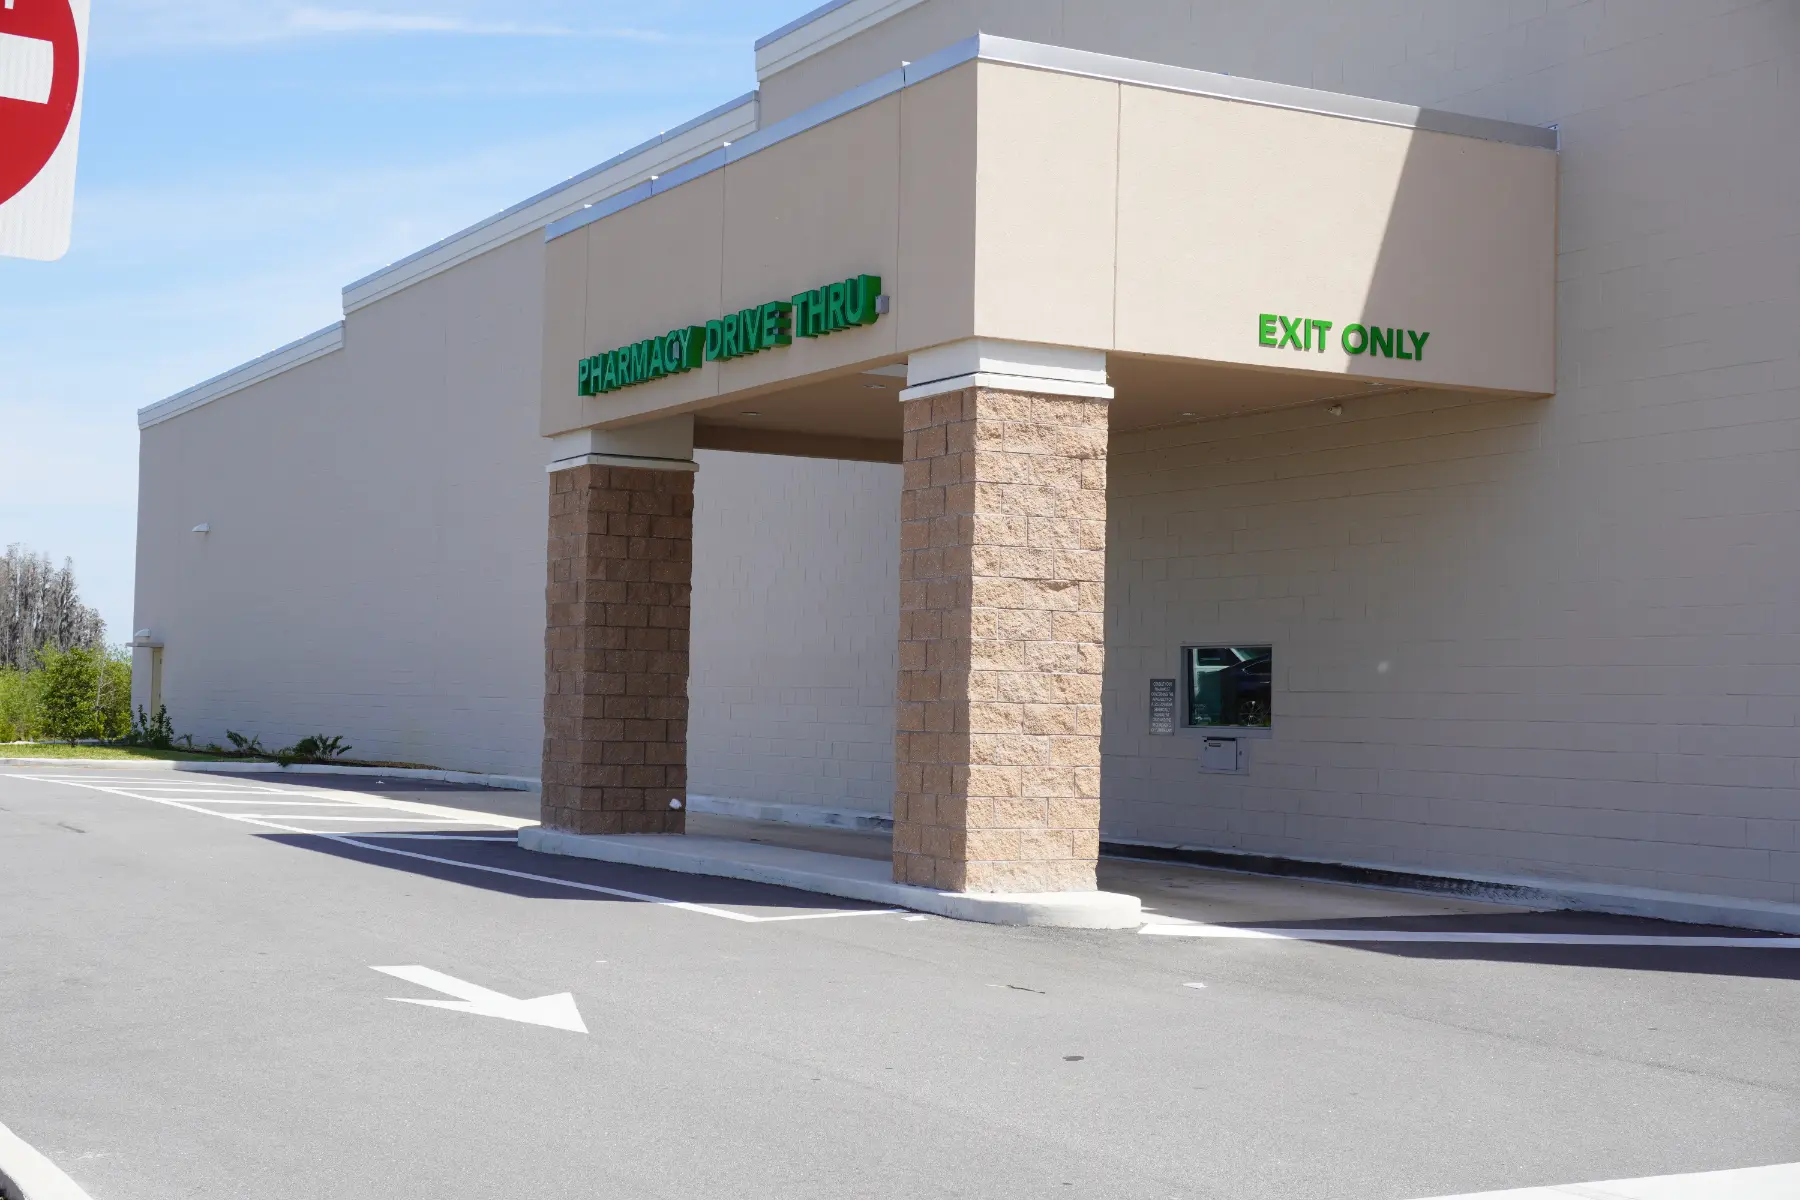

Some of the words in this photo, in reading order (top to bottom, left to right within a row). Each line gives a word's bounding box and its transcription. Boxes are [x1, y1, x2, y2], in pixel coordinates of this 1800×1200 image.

[578, 326, 705, 396] PHARMACY
[706, 301, 792, 361] DRIVE
[792, 274, 880, 338] THRU
[1259, 313, 1333, 352] EXIT
[1342, 323, 1430, 361] ONLY
